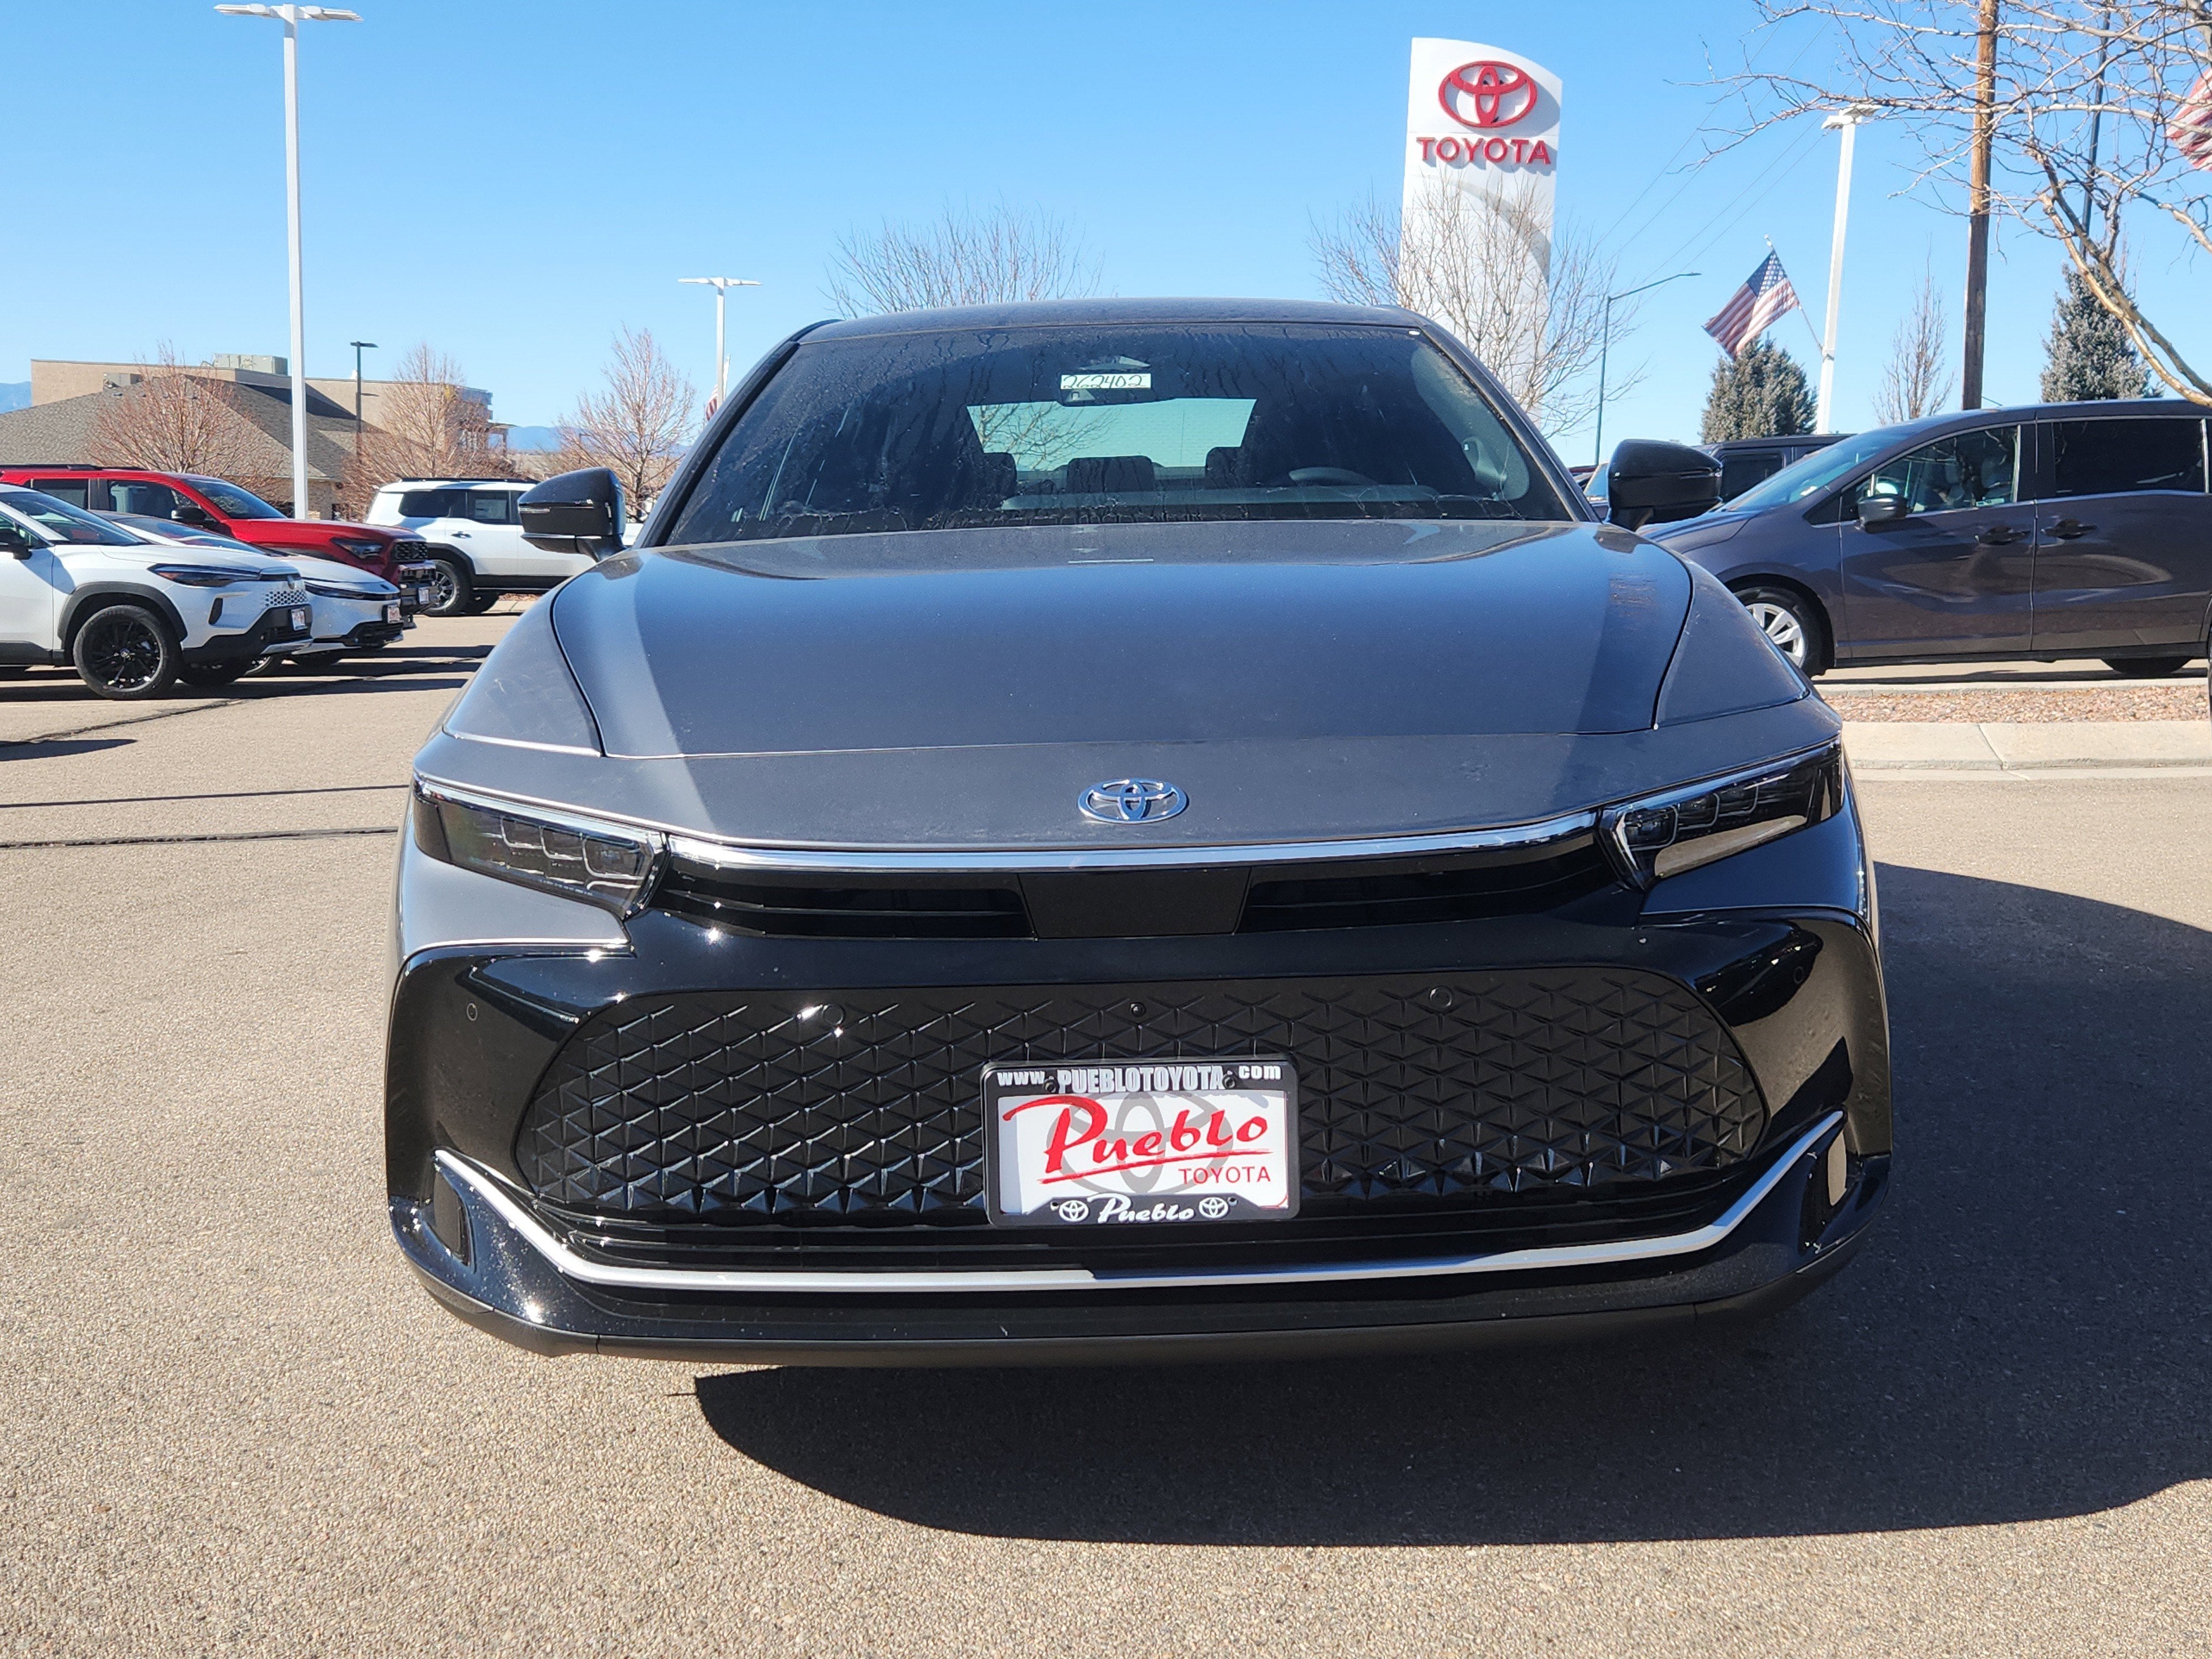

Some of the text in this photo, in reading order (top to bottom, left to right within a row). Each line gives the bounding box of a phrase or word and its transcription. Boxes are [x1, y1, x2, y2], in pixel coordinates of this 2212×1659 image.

[1416, 137, 1551, 164] TOYOTA
[1063, 374, 1147, 389] 262402
[1002, 1095, 1268, 1174] Pueblo
[1178, 1165, 1271, 1185] TOYOTA
[1086, 1193, 1194, 1224] Pueblo
